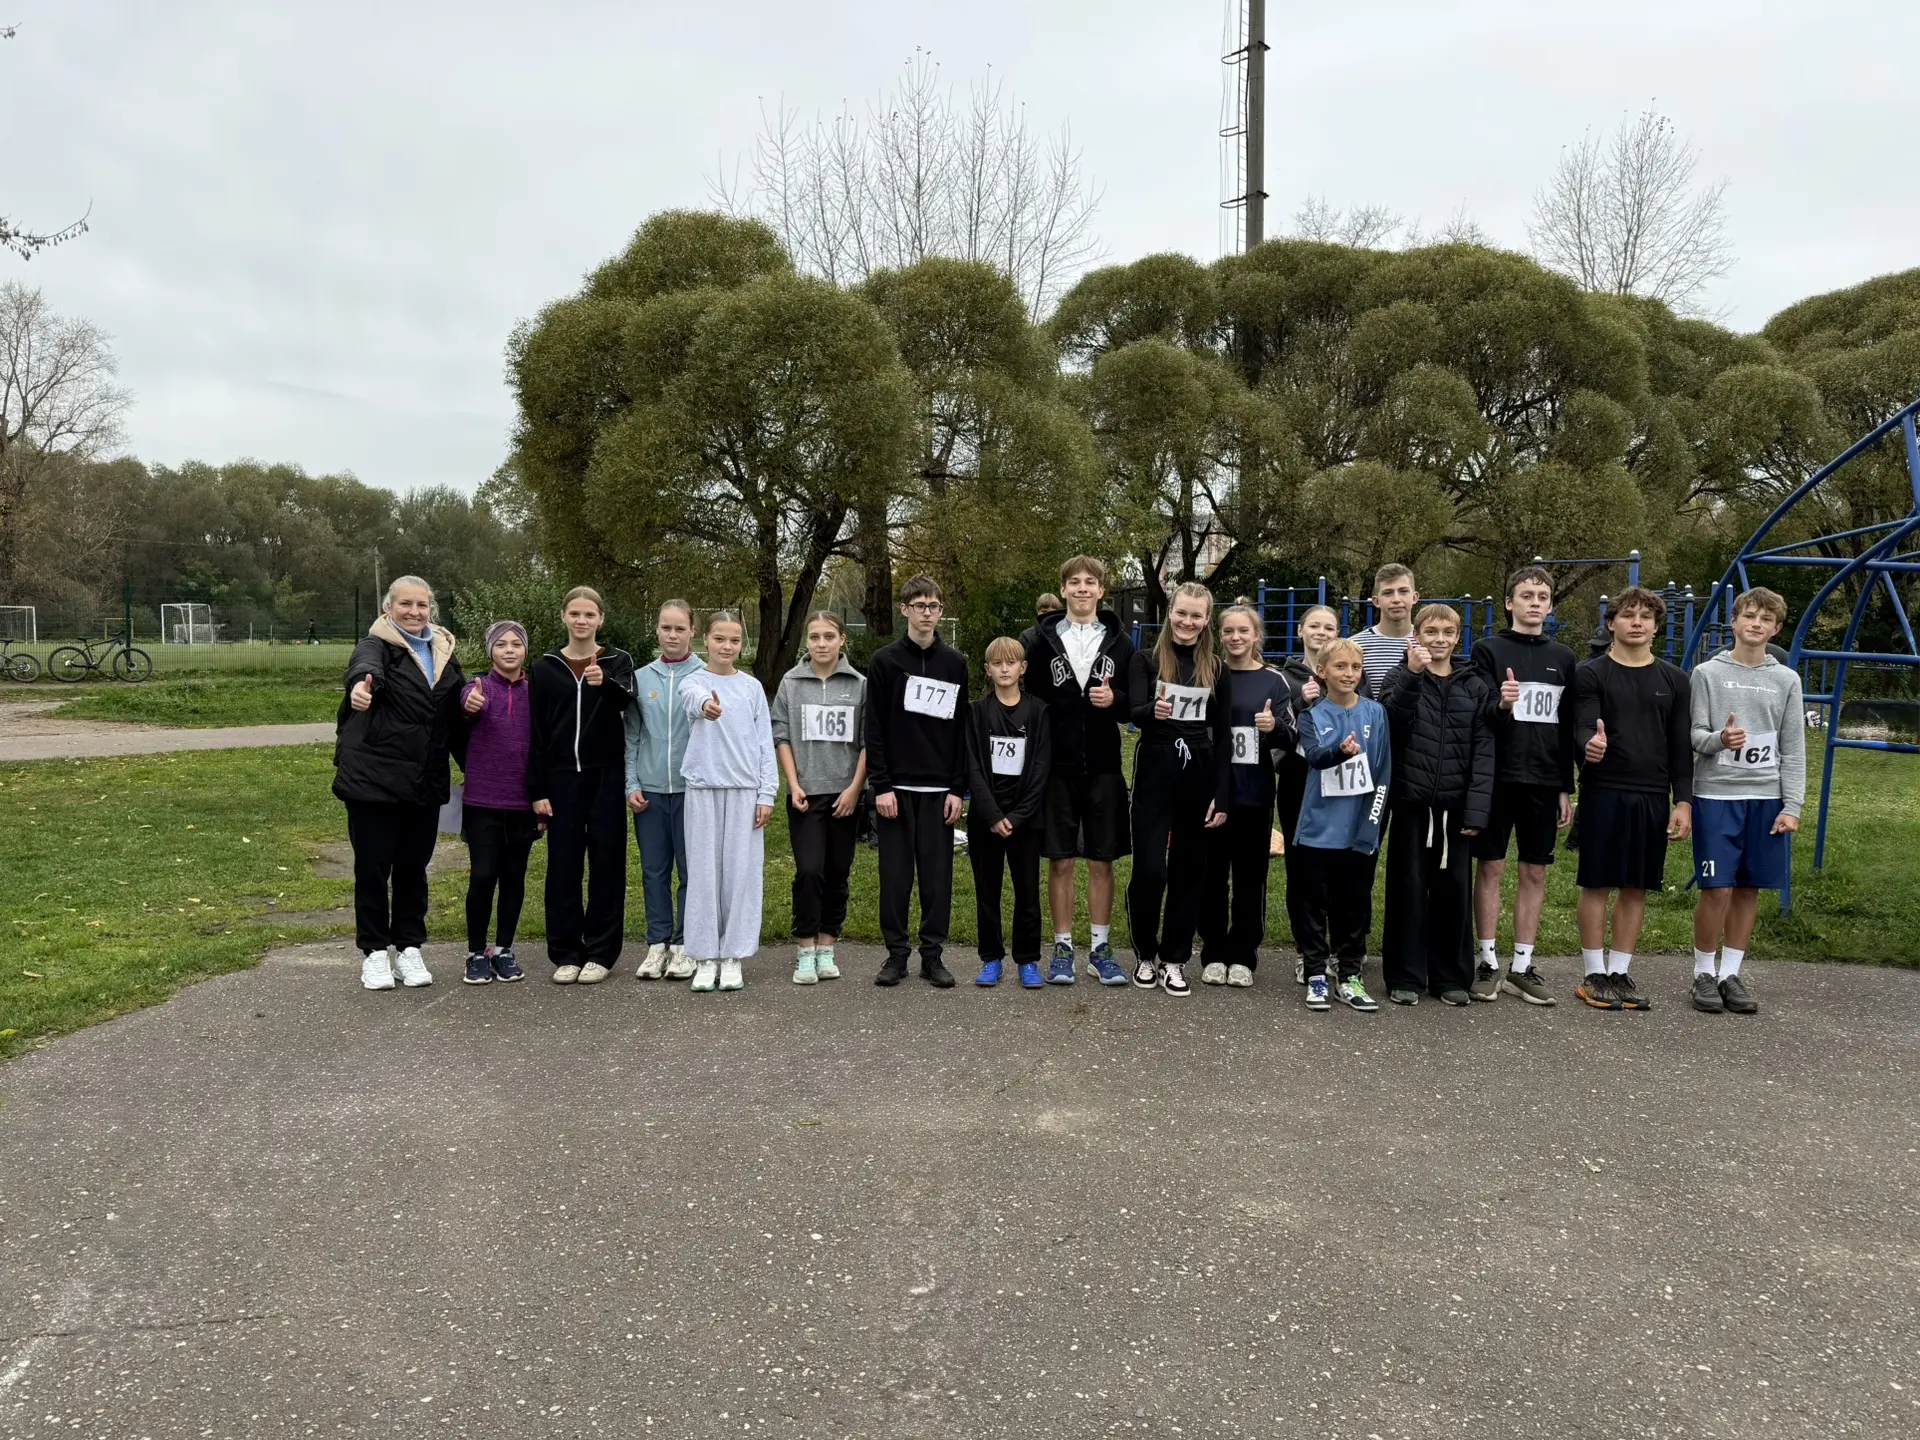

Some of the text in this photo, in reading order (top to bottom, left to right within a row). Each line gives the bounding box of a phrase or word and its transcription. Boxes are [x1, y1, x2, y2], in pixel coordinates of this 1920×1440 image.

[913, 683, 947, 705] 177
[1723, 681, 1777, 694] Champion
[1165, 694, 1204, 719] 171
[1523, 689, 1553, 717] 180
[816, 710, 847, 737] 165
[1363, 725, 1371, 739] 5
[990, 740, 1016, 758] 178
[1334, 760, 1367, 791] 173
[1701, 859, 1715, 877] 21
